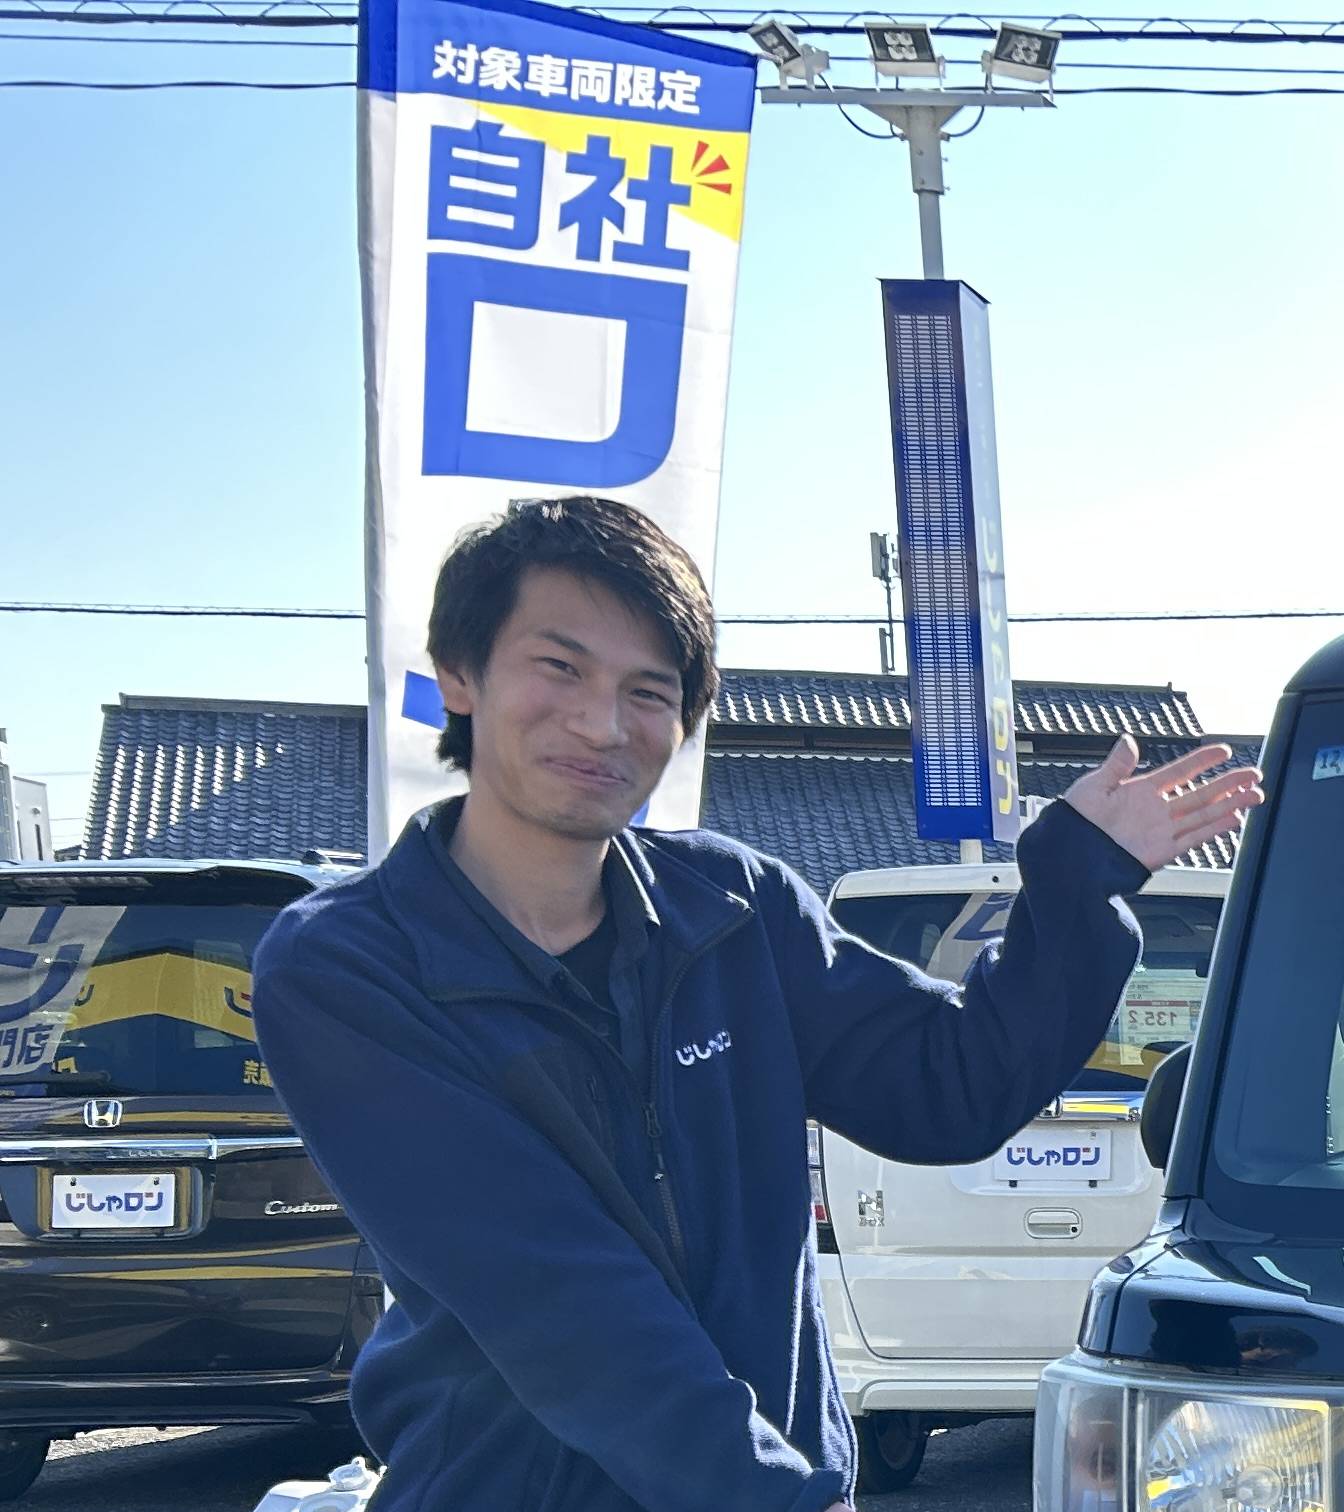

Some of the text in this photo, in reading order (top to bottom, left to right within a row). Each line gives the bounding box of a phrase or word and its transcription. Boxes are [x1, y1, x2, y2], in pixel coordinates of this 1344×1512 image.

[432, 40, 702, 115] 対象車両限定
[427, 119, 691, 271] 自社
[1006, 1146, 1101, 1167] じしゃロン
[65, 1192, 164, 1213] じしゃロン
